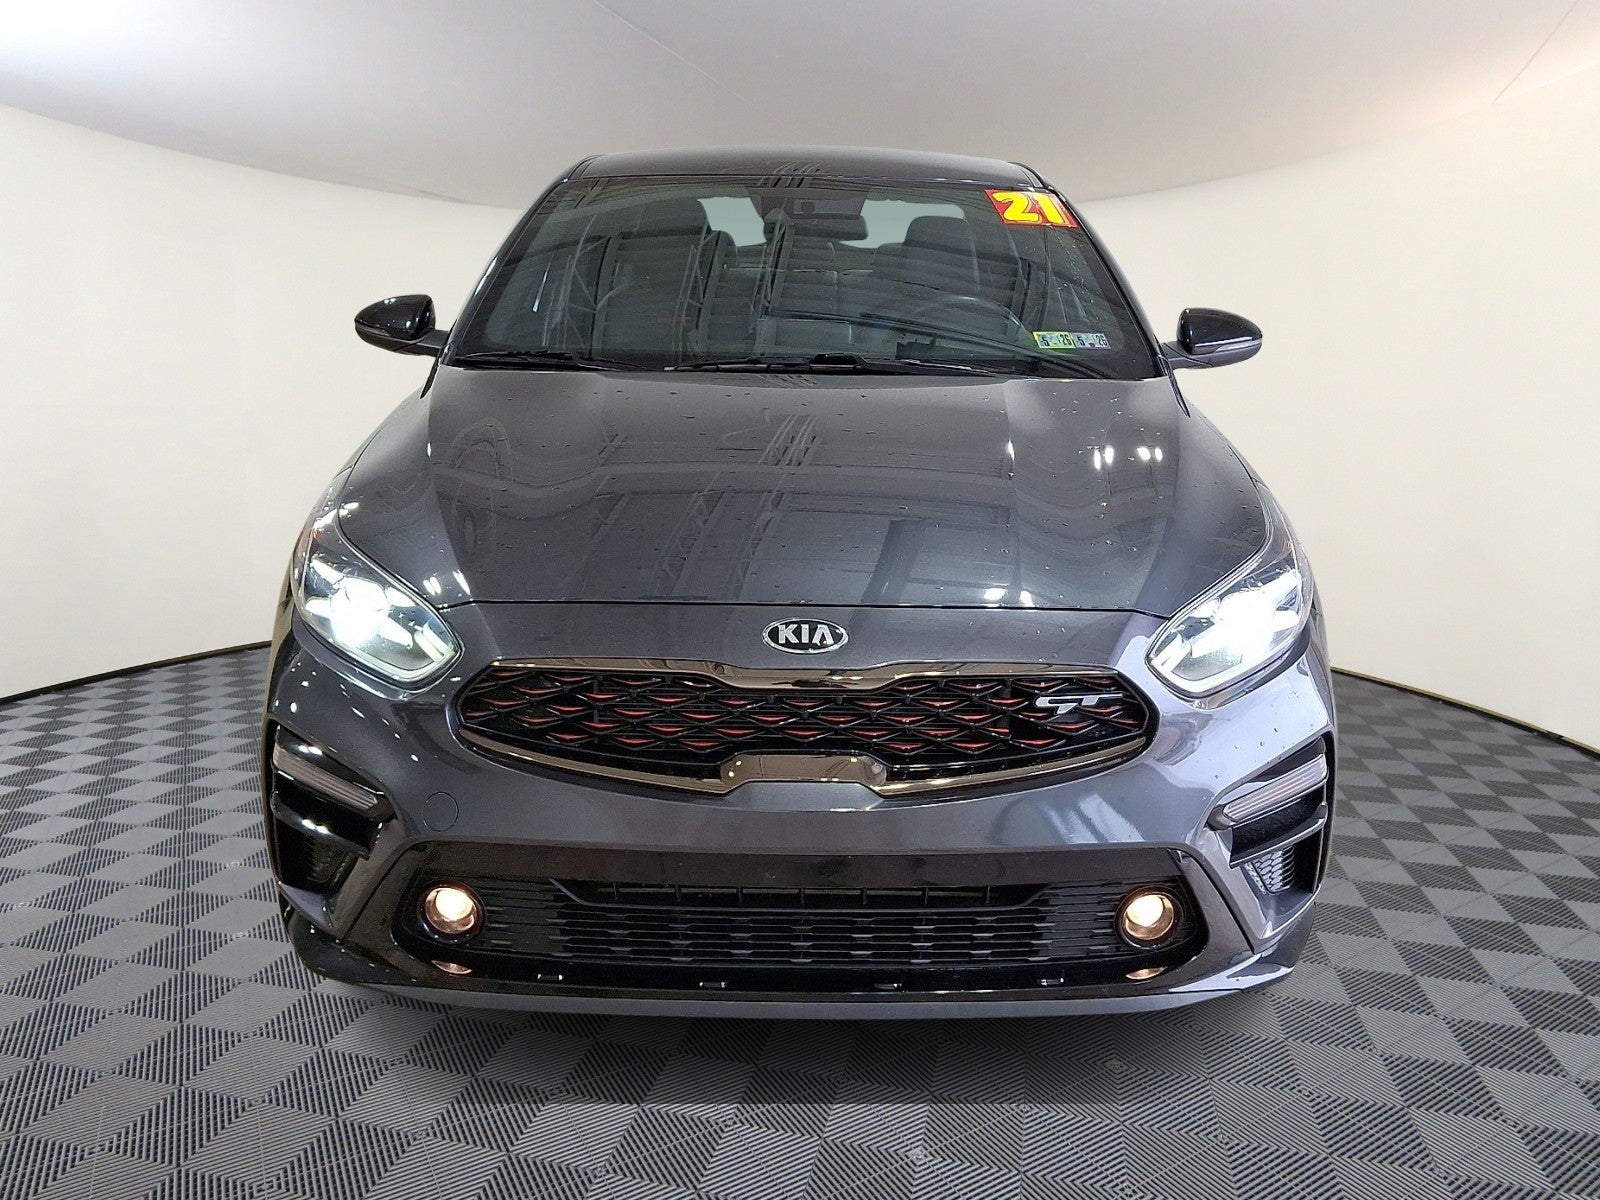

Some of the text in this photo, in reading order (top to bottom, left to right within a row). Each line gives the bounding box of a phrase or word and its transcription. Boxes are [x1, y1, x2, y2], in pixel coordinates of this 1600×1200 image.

[992, 191, 1065, 224] 21
[778, 624, 834, 645] KIA
[1035, 694, 1122, 714] GT
